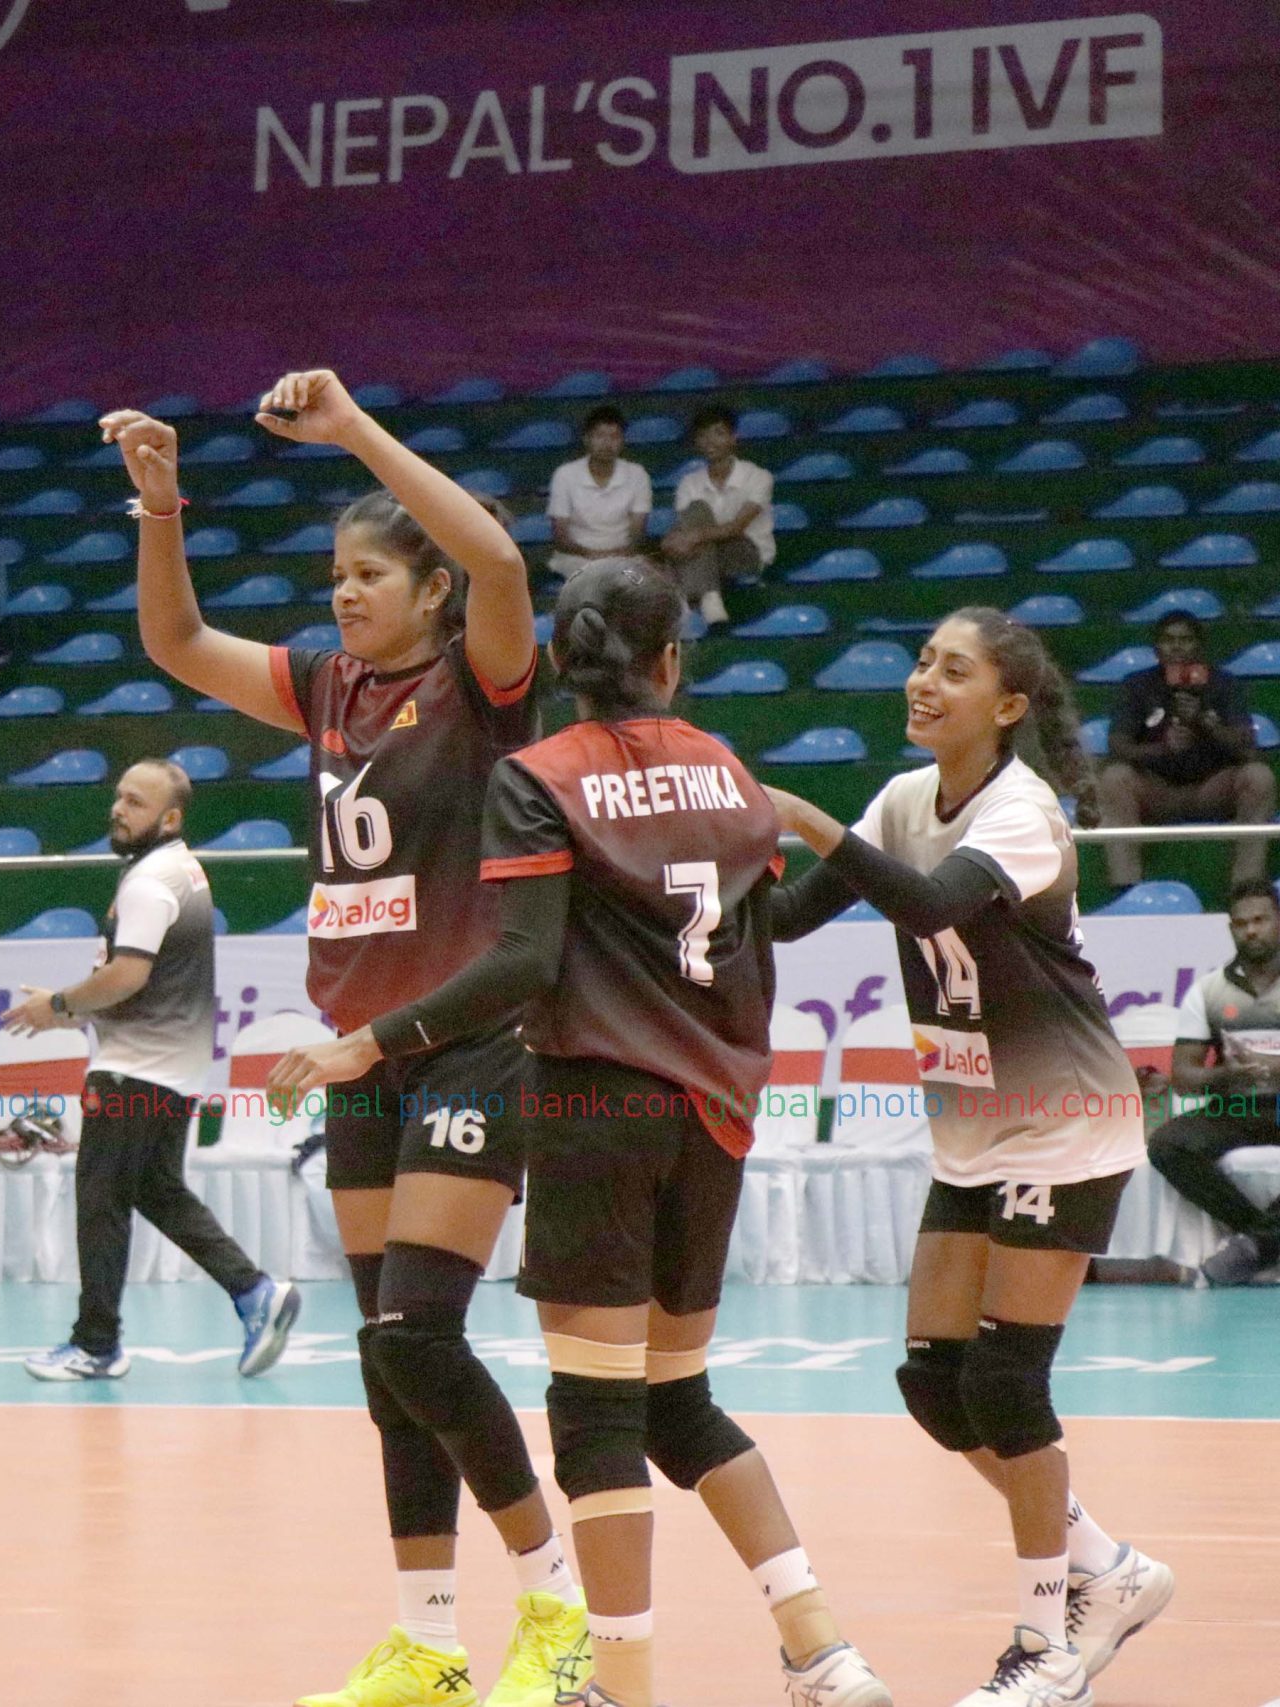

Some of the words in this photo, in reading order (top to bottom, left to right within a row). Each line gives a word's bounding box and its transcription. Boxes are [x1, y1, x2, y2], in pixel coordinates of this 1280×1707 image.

[254, 77, 658, 193] NEPAL'S
[692, 47, 934, 160] NO.1
[971, 32, 1146, 136] IVF
[319, 762, 393, 872] 16
[580, 765, 749, 819] PREETHIKA
[327, 896, 412, 927] Dialog
[663, 861, 722, 988] 7
[422, 1106, 487, 1154] 16
[997, 1180, 1056, 1225] 14
